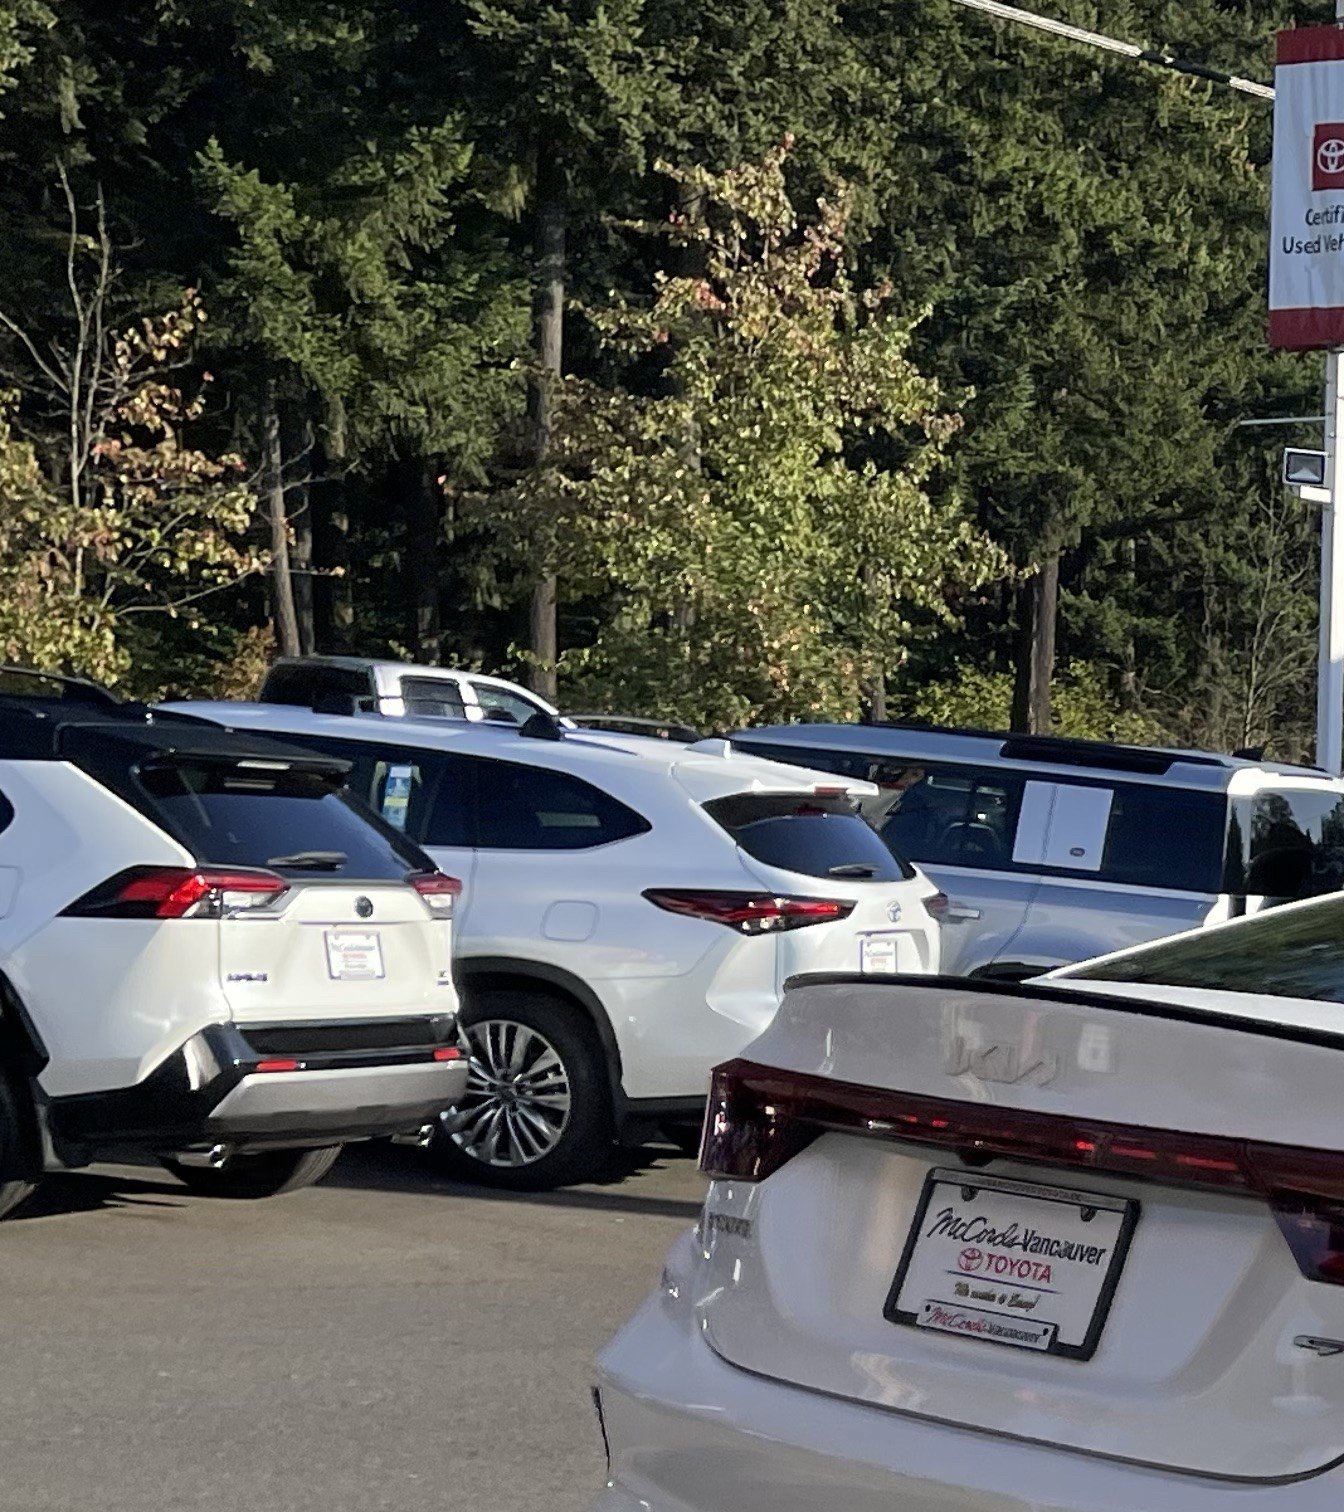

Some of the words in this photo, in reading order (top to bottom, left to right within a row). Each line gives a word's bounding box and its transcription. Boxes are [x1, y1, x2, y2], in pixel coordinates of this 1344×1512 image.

[1282, 234, 1321, 254] Used
[1021, 1228, 1107, 1266] Vancouver
[984, 1252, 1052, 1284] TOYOTA
